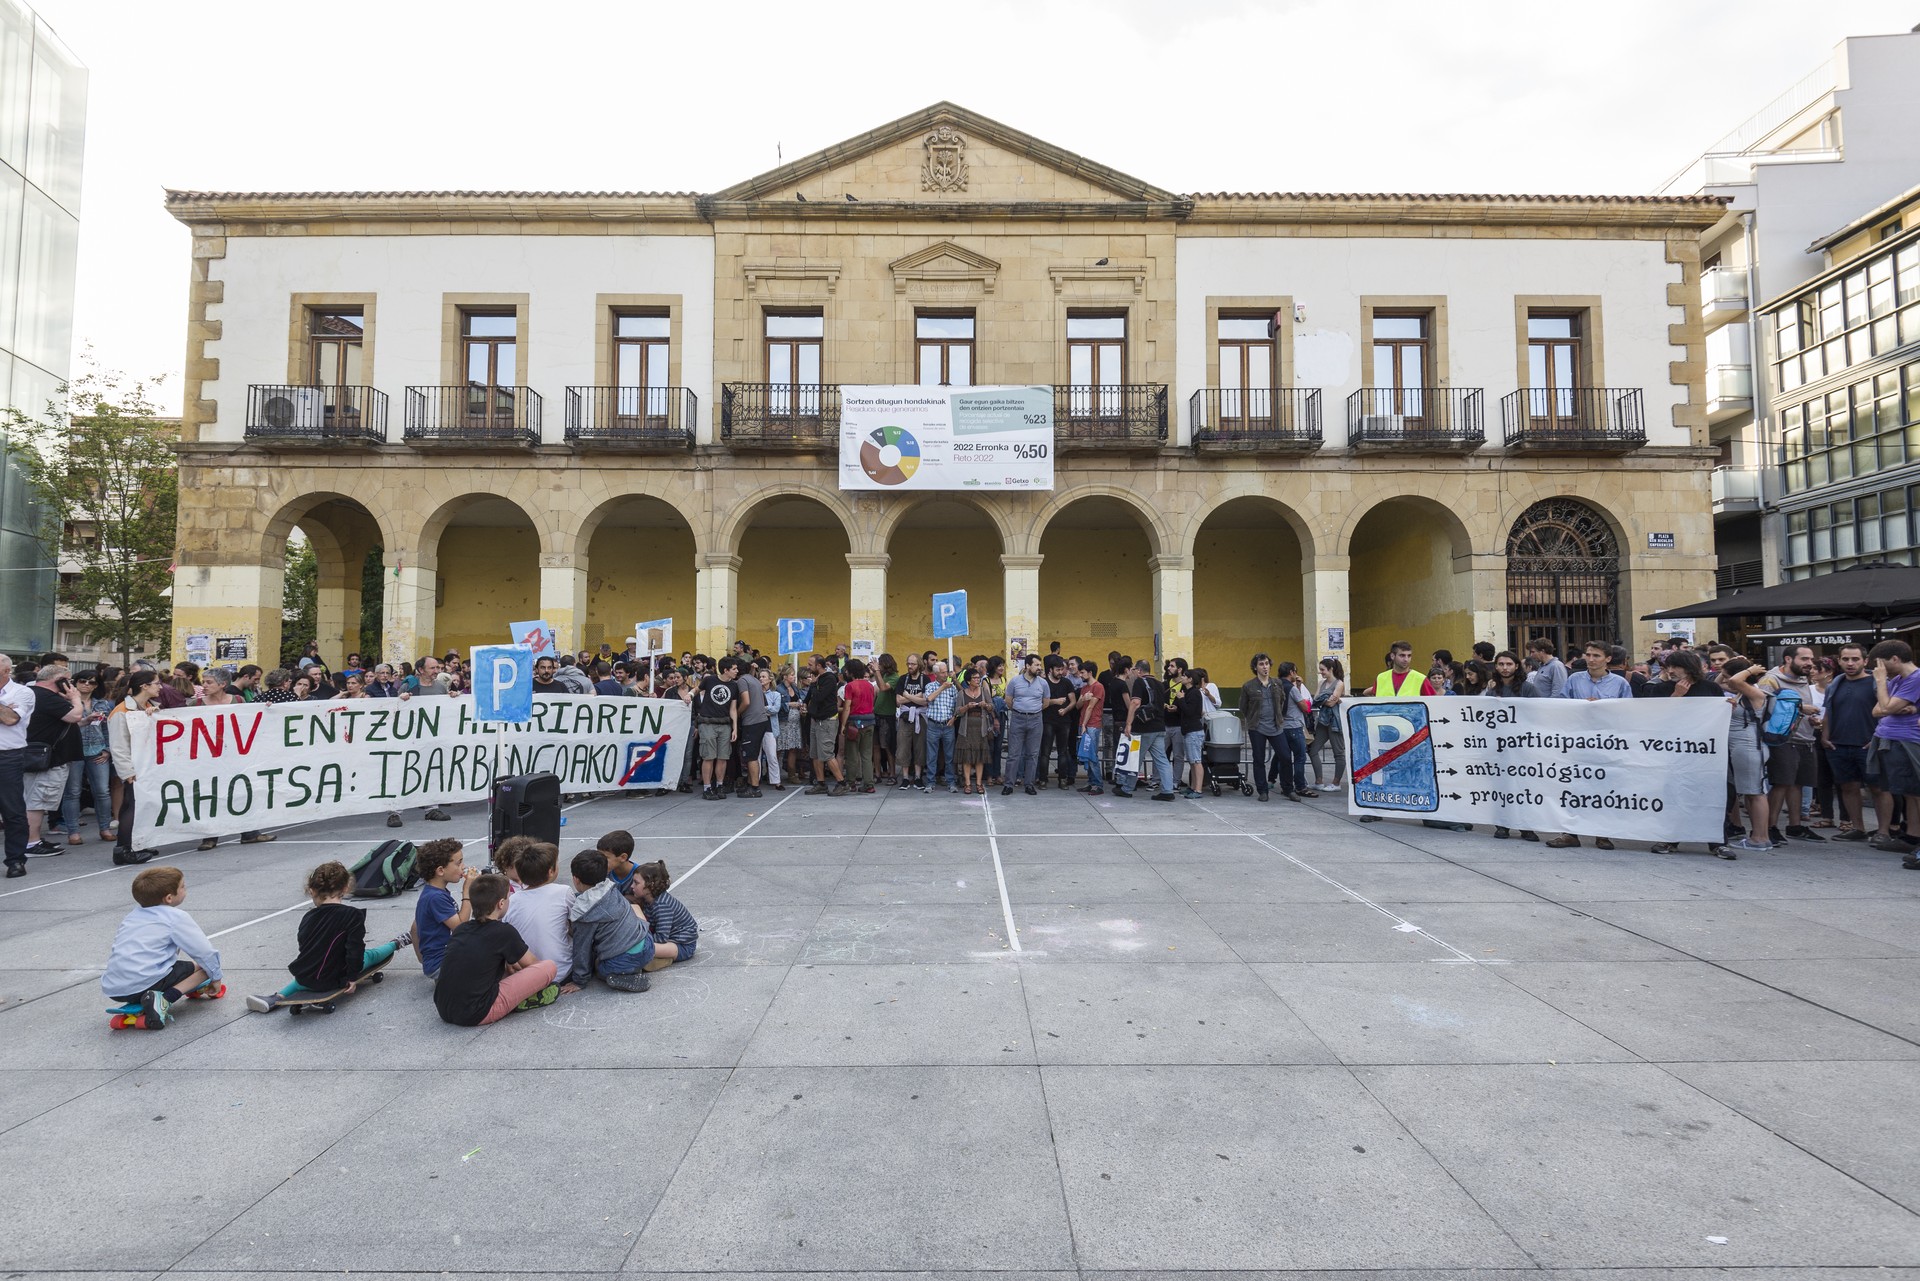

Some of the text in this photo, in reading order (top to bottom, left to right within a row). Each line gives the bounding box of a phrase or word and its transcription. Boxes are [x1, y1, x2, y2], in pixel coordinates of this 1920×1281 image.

[875, 398, 903, 406] ditugun
[1023, 414, 1047, 425] %23
[953, 443, 1009, 451] 2022 Erronka
[953, 454, 972, 462] Reto
[973, 454, 994, 462] 2022
[1013, 444, 1048, 459] %50
[940, 603, 955, 630] P
[787, 620, 805, 650] P
[493, 657, 518, 711] P
[1460, 705, 1517, 729] ilegal
[156, 711, 263, 765] PNV
[284, 705, 441, 747] ENTZUN
[1463, 732, 1717, 755] sin participación vecinal
[1365, 715, 1416, 786] P
[1465, 761, 1606, 783] anti-ecológico
[155, 762, 357, 827] AHOTSA:
[1361, 790, 1431, 806] IBARBENGOA
[1469, 788, 1664, 813] proyecto faraónico
